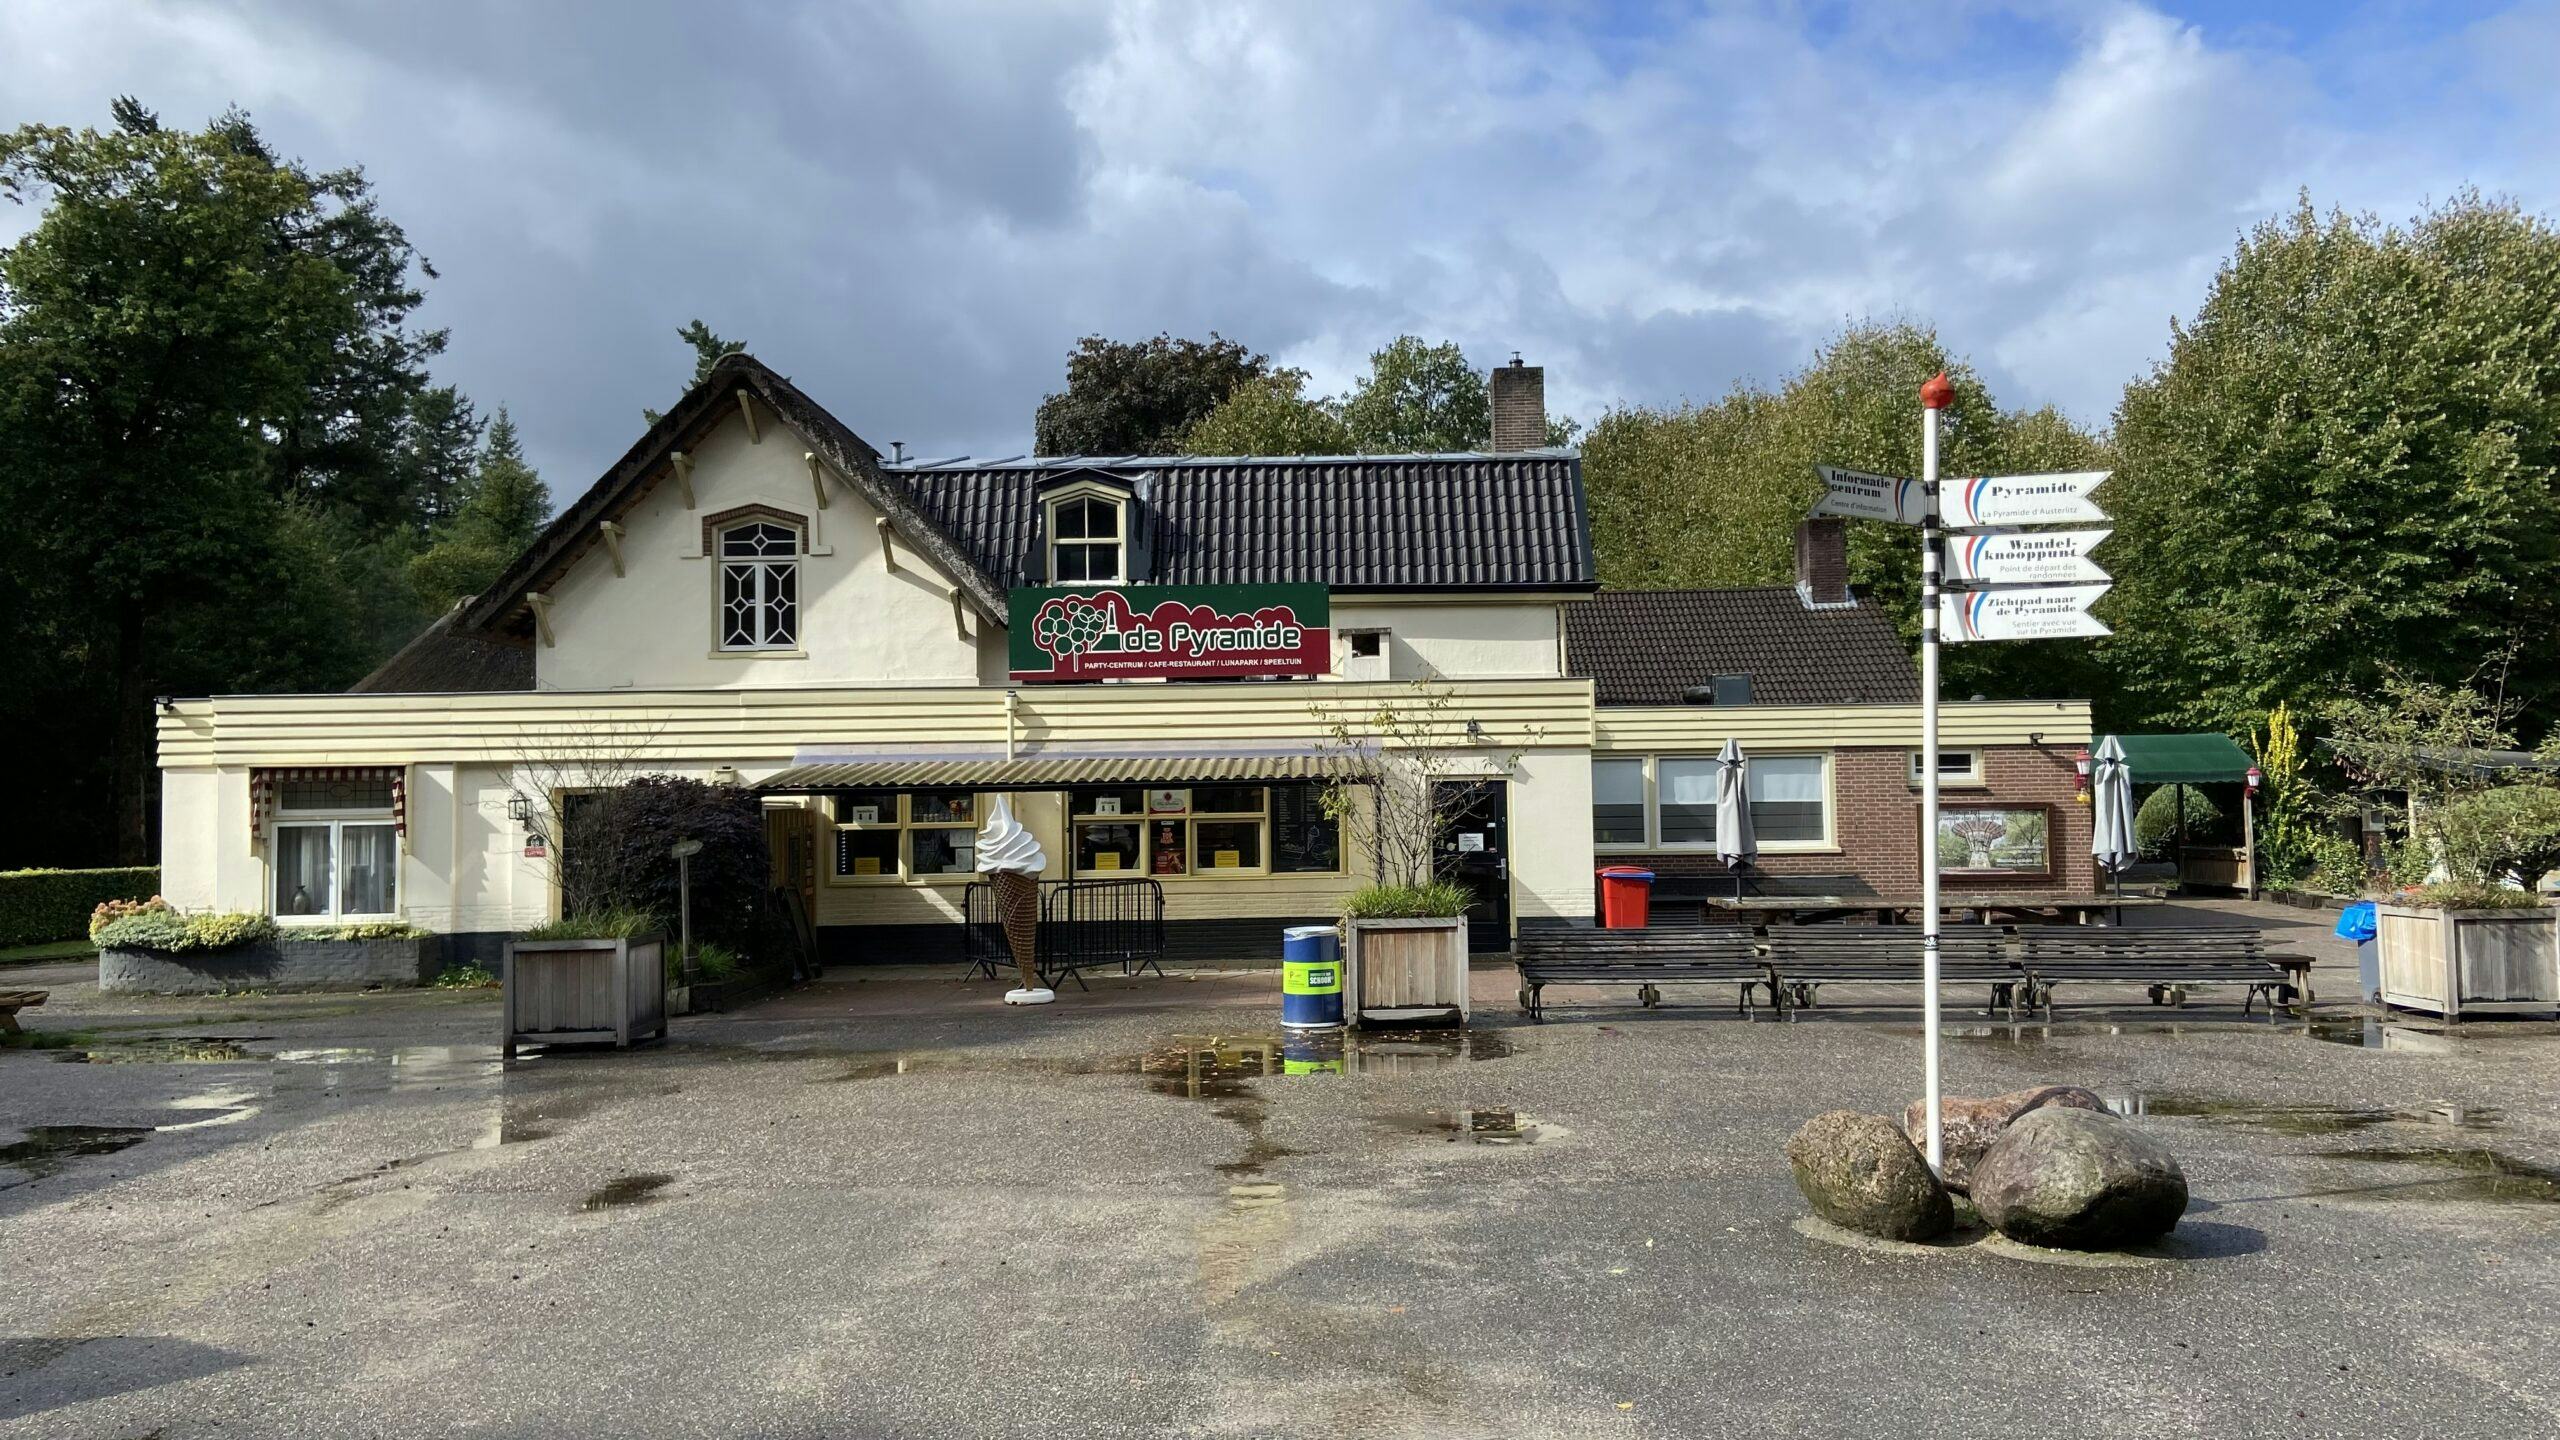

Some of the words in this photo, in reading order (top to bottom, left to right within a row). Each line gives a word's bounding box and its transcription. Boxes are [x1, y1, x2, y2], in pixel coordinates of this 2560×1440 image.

[1831, 470, 1891, 489] Informatie
[1831, 483, 1881, 498] centrum
[1992, 482, 2077, 499] Pyramide
[1831, 500, 1850, 509] Centre
[1851, 502, 1887, 513] d'information
[1993, 509, 2031, 518] Pyramide
[2010, 537, 2077, 550] Wandel-
[1984, 548, 2077, 562] knooppunt
[2000, 565, 2021, 573] Point
[2035, 564, 2061, 574] départ
[2062, 563, 2077, 571] des
[1988, 596, 2042, 608] Zichtpad
[2046, 596, 2077, 604] naar
[1996, 607, 2011, 616] de
[2015, 604, 2077, 617] Pyramide
[2012, 620, 2040, 629] Sentier
[2016, 627, 2028, 635] sur
[2030, 626, 2038, 634] la
[2039, 625, 2077, 635] Pyramide
[1125, 622, 1162, 653] de
[1169, 620, 1301, 657] Pyramide
[1084, 661, 1144, 670] PARTY-CENTRUM
[1148, 660, 1216, 669] CAFE-RESTAURANT
[1220, 659, 1259, 667] LUNAPARK
[1263, 658, 1302, 666] SPEELTUIN
